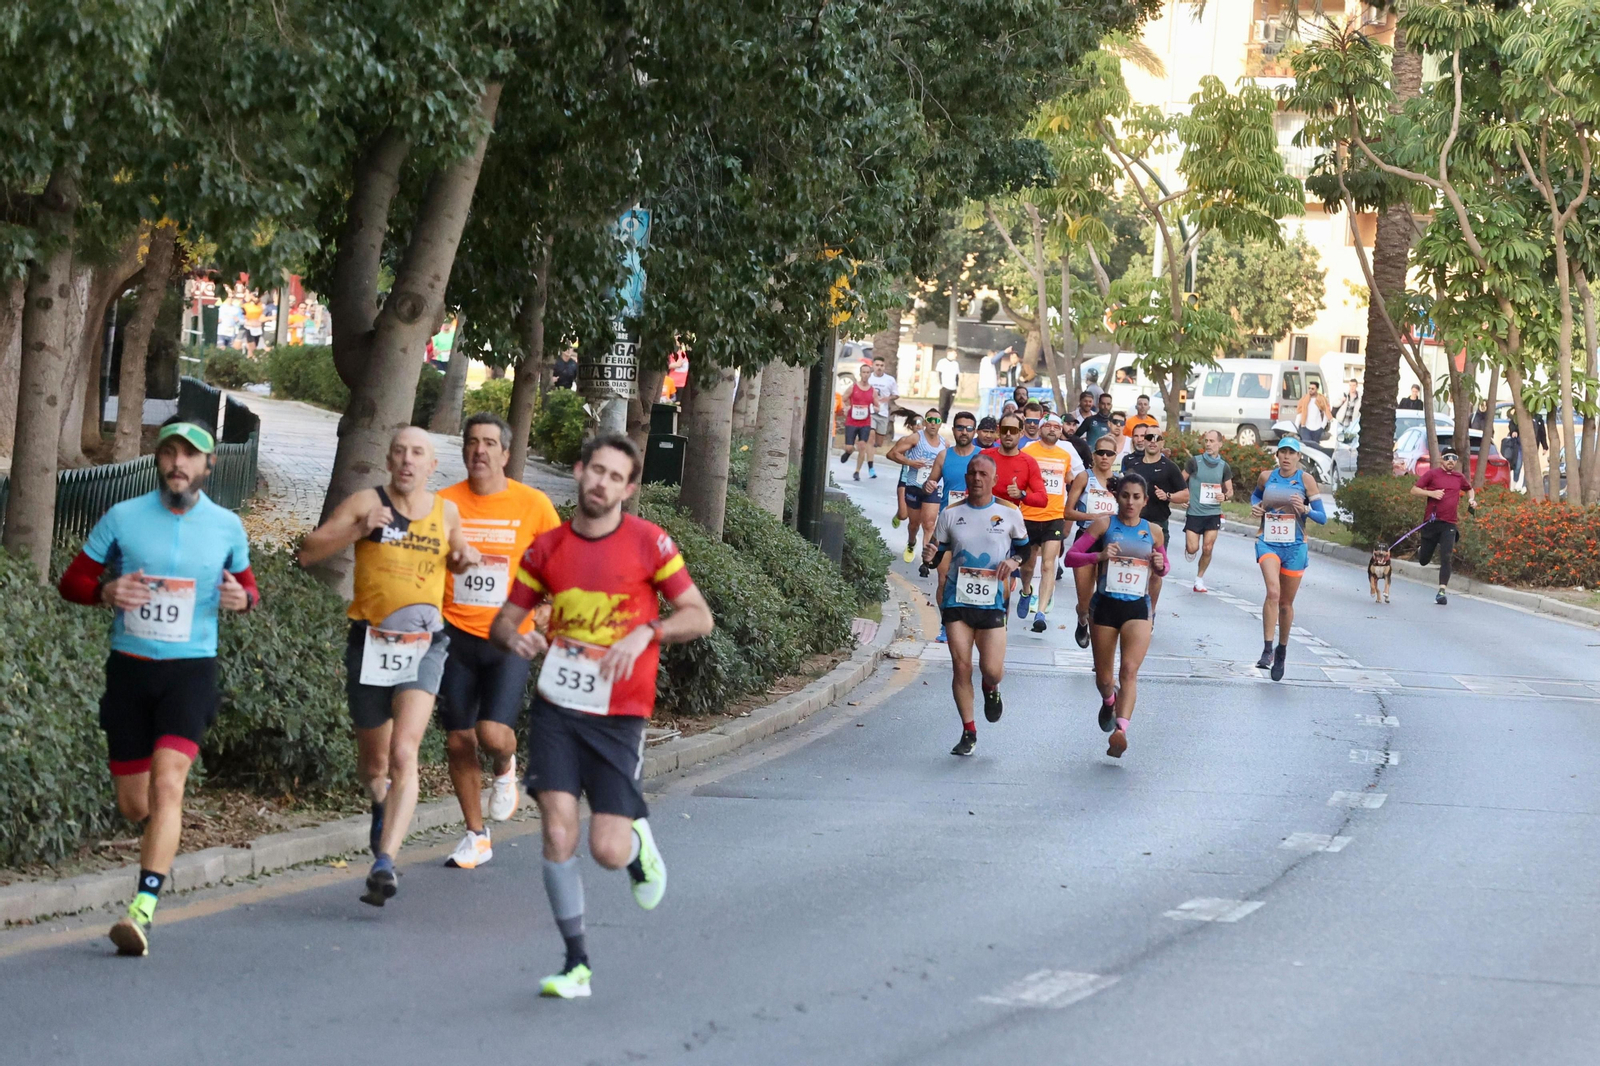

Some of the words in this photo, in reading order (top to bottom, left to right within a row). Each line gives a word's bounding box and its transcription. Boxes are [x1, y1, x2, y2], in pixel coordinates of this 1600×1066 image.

[605, 356, 637, 365] FERIAL
[603, 366, 612, 379] 5
[615, 366, 636, 380] DIC
[1094, 500, 1113, 511] 300
[1270, 525, 1289, 535] 313
[464, 575, 495, 592] 499
[1117, 571, 1140, 585] 197
[965, 582, 990, 596] 836
[139, 602, 180, 623] 619
[379, 653, 413, 671] 151
[555, 667, 596, 693] 533
